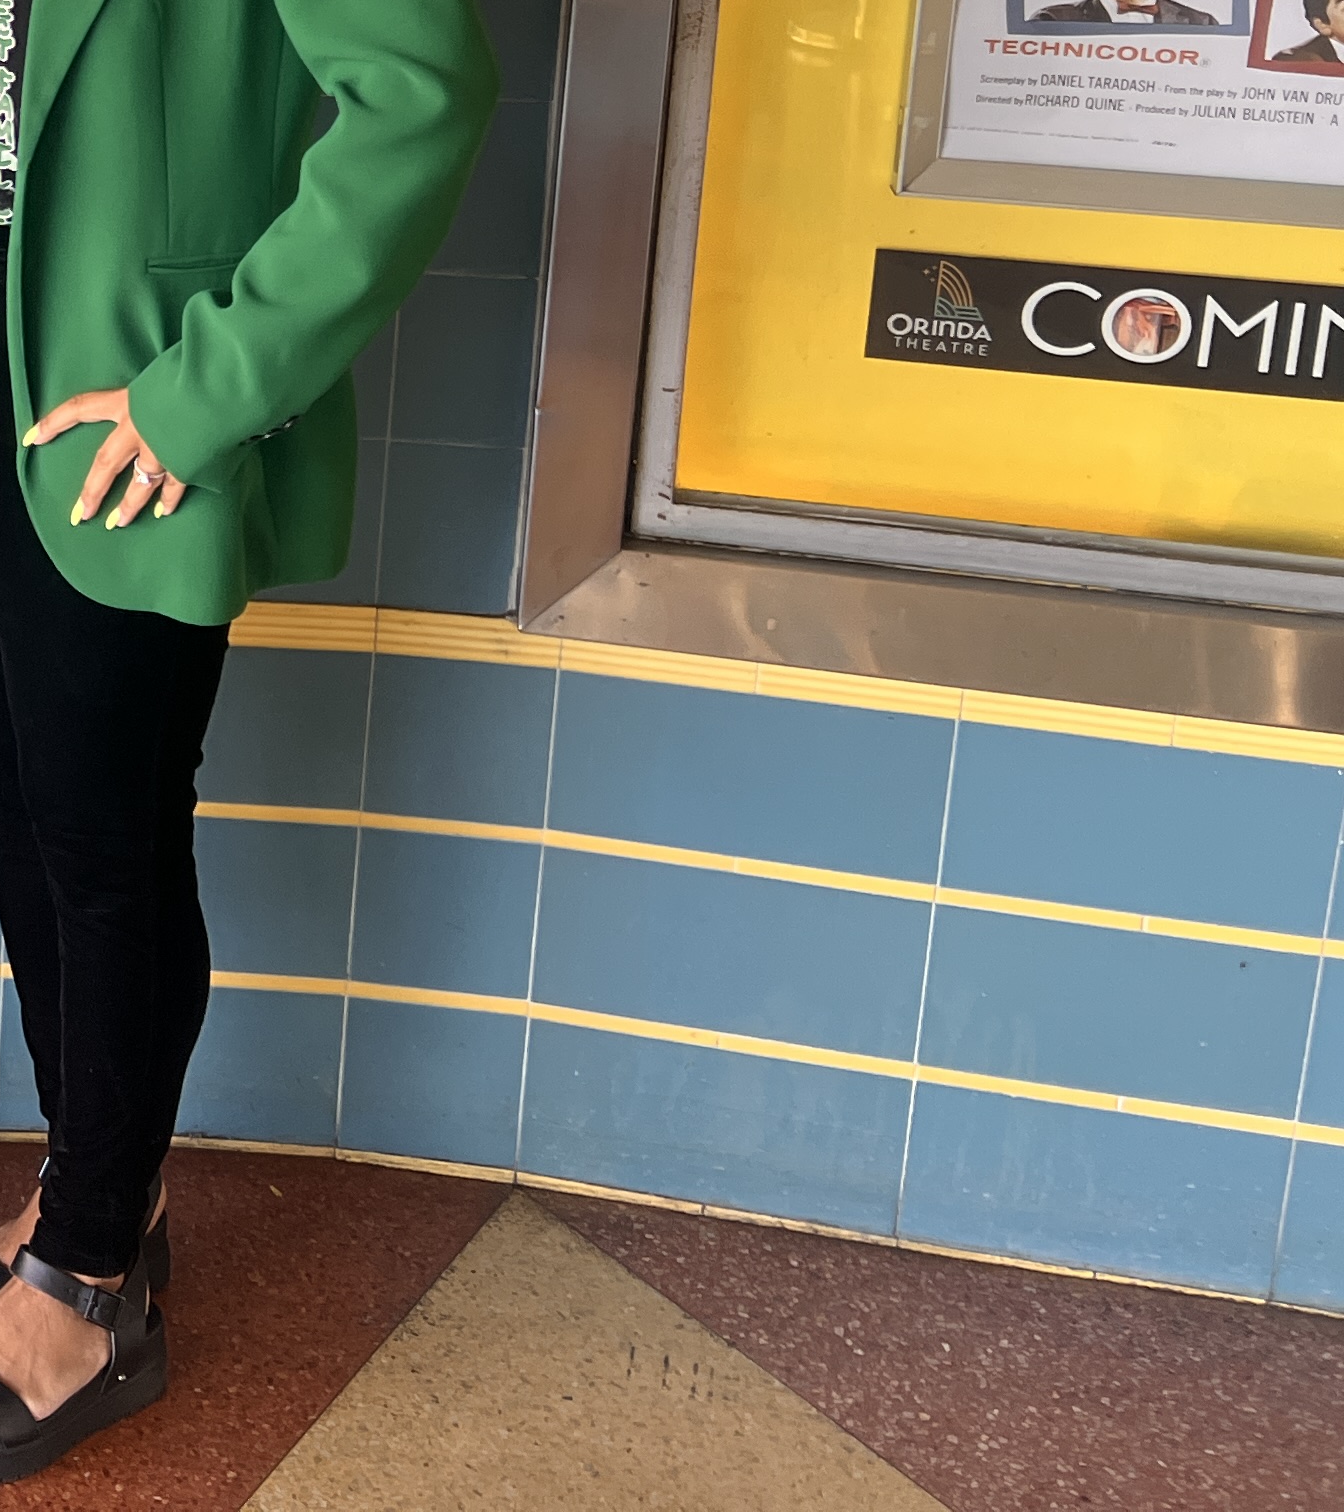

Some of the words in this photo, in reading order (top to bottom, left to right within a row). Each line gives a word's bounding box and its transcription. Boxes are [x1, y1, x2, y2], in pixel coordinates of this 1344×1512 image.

[1039, 74, 1086, 90] DANIEL
[1087, 76, 1156, 93] TARADASH
[1241, 86, 1276, 102] JOHN
[1281, 88, 1310, 104] VAN
[1024, 93, 1080, 110] RICHARD
[1084, 96, 1125, 113] QUINE
[1191, 103, 1237, 120] JULIAN
[1242, 107, 1316, 126] BLAUSTEIN
[886, 313, 993, 343] ORINDA
[893, 336, 990, 357] THEATRE
